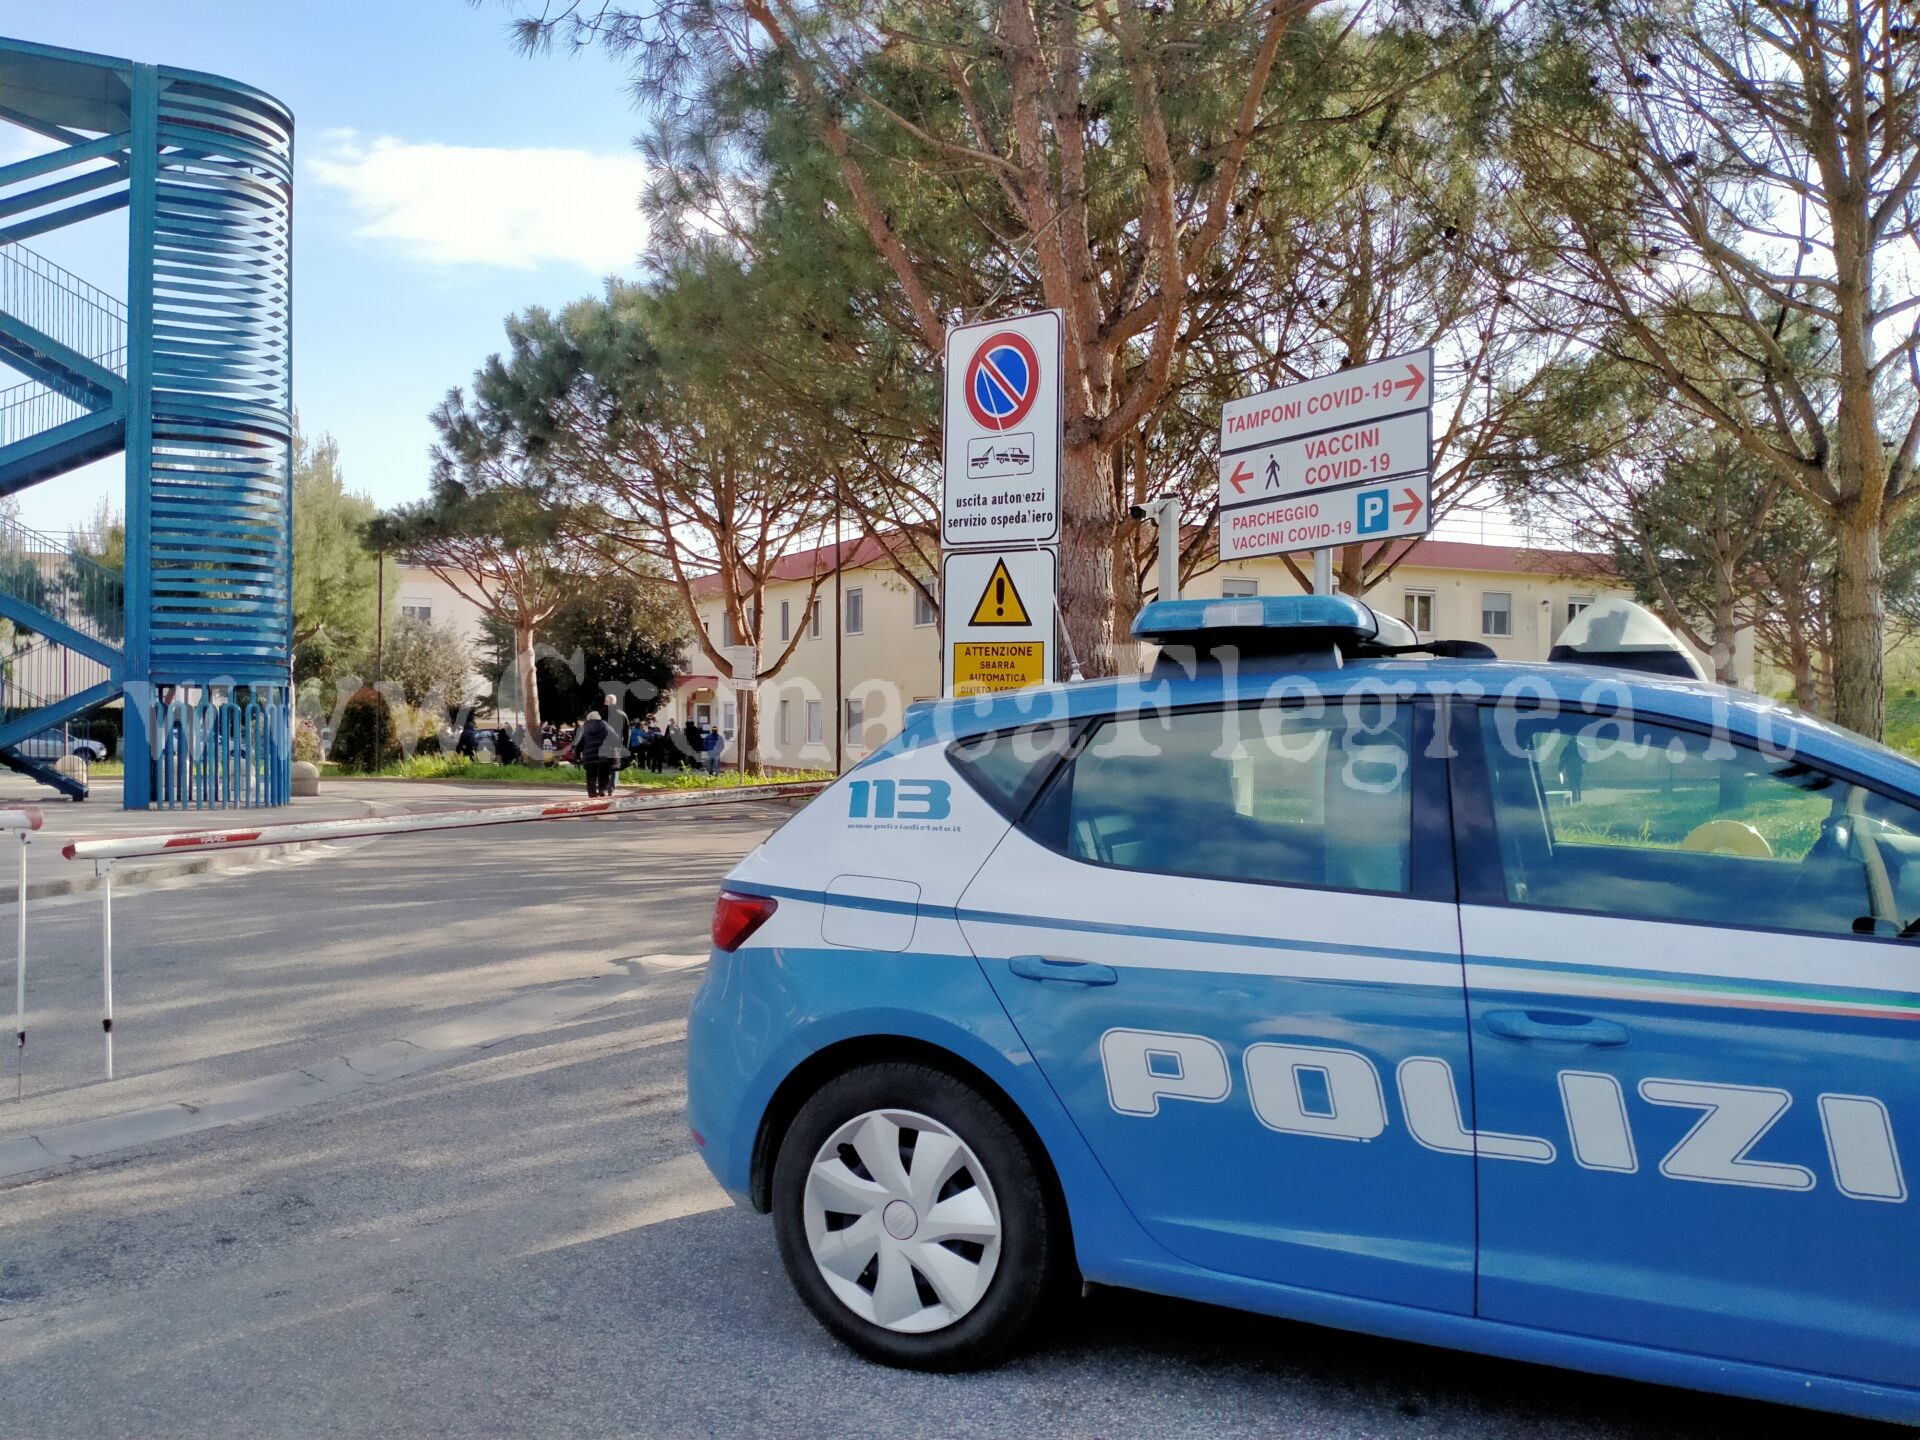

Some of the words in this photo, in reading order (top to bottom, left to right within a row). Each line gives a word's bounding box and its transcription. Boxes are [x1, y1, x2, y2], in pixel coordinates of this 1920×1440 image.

[1227, 400, 1301, 434] TAMPONI
[1307, 379, 1393, 415] COVID-19
[1305, 428, 1380, 460] VACCINI
[1305, 453, 1390, 485] COVID-19
[956, 493, 988, 508] uscita
[1364, 496, 1383, 528] P
[948, 513, 987, 528] servizio
[1232, 503, 1319, 530] PARCHEGGIO
[1232, 531, 1284, 551] VACCINI
[1288, 520, 1352, 544] COVID-19
[964, 646, 1033, 657] ATTENZIONE
[980, 661, 1016, 670] SBARRA
[969, 673, 1026, 682] AUTOMATICA
[848, 779, 952, 820] 113
[1099, 1026, 1908, 1203] POLIZI
